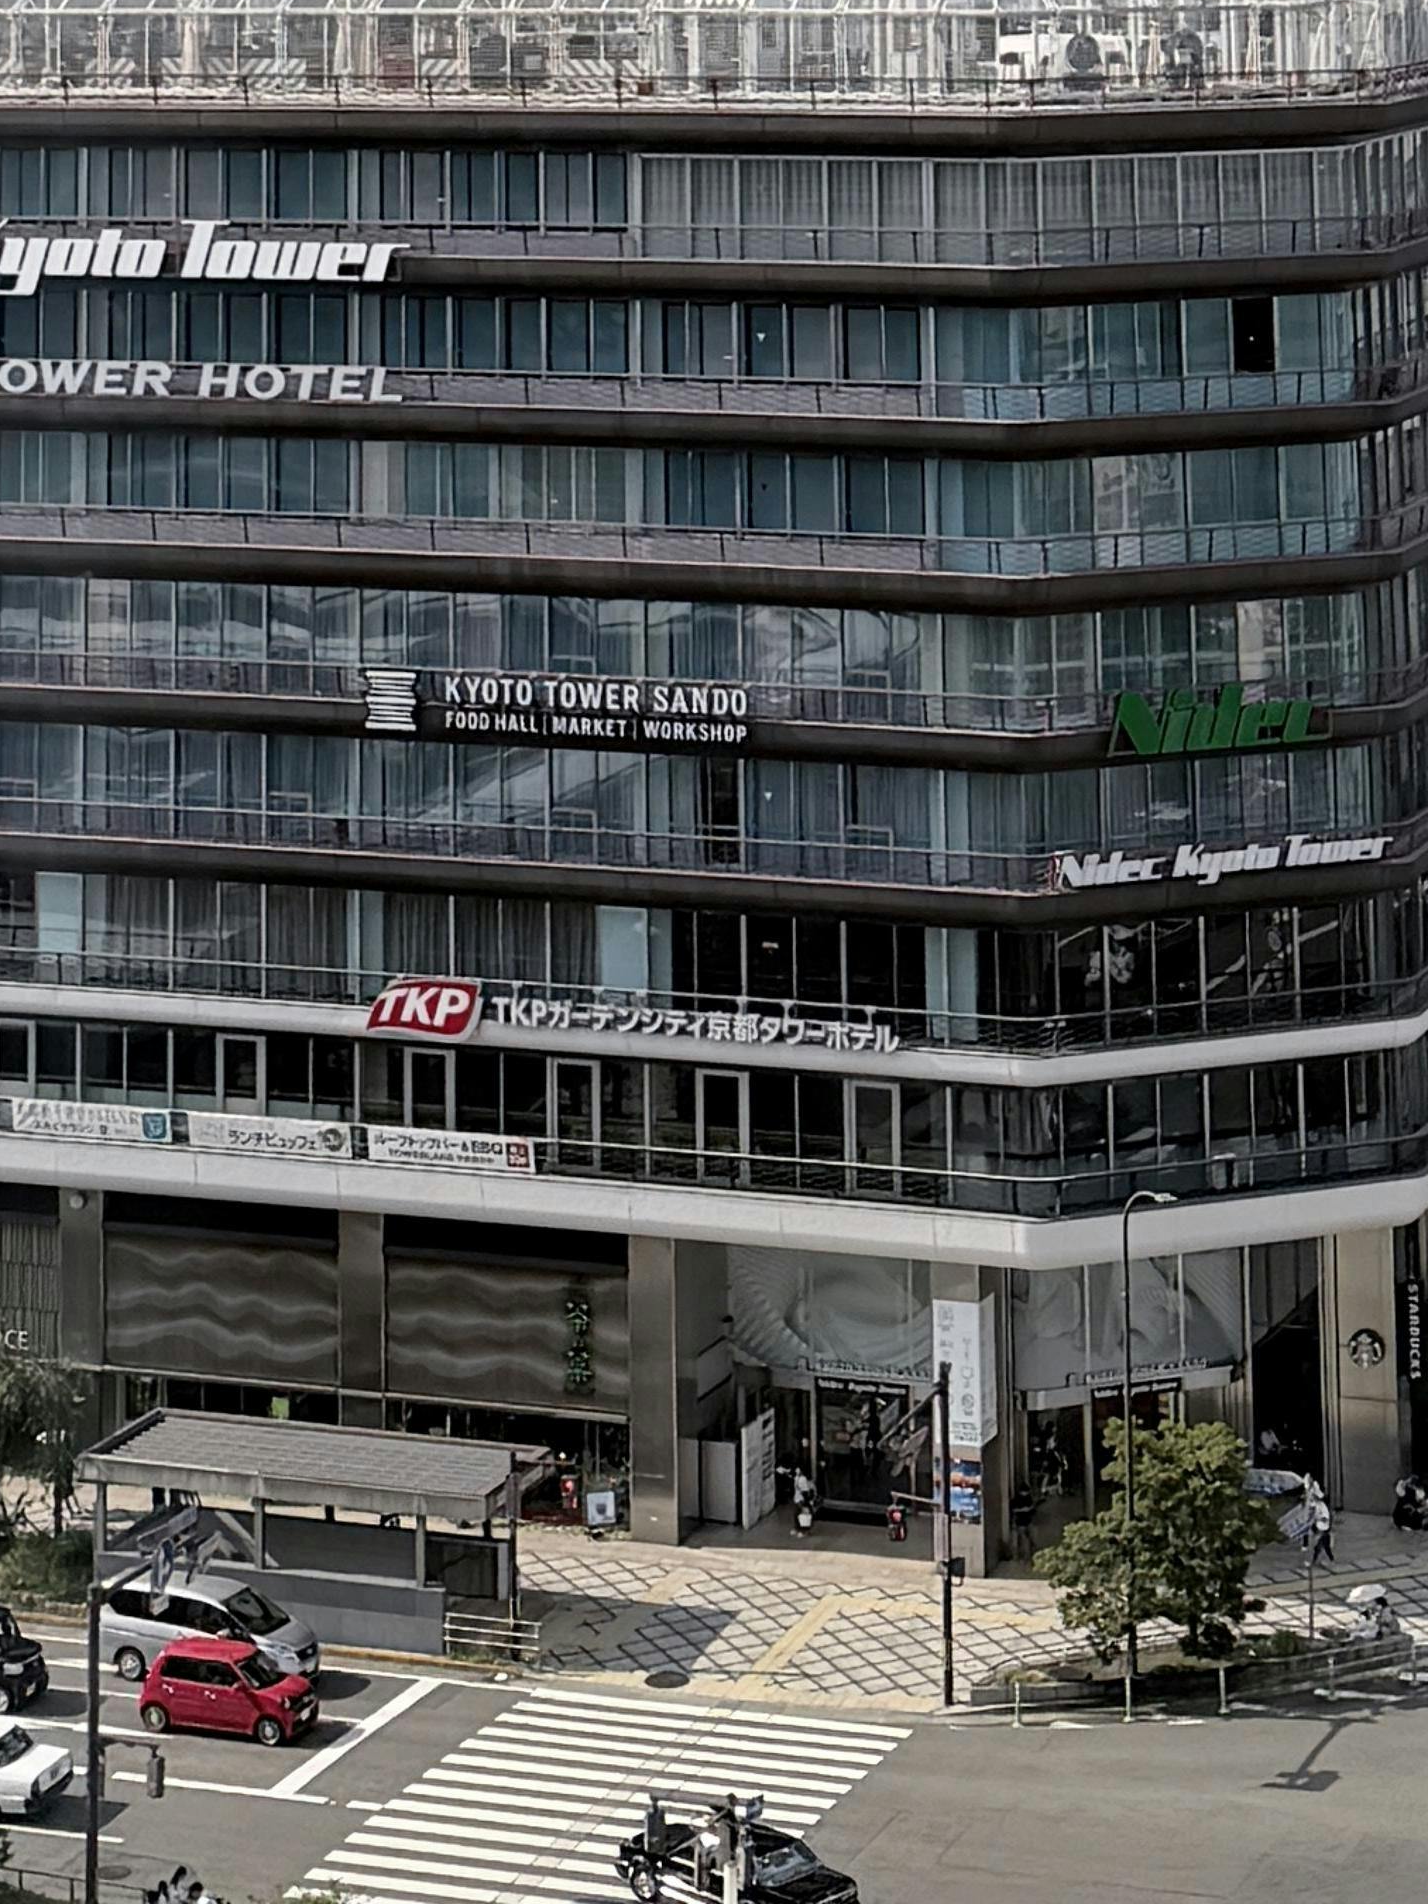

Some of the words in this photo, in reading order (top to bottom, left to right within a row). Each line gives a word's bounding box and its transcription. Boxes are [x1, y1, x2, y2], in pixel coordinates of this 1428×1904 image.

[180, 220, 411, 282] Tower
[198, 364, 403, 402] HOTEL
[445, 675, 533, 706] KYOTO
[544, 679, 640, 714] TOWER
[652, 686, 748, 717] SANDO
[445, 711, 489, 732] FOOD
[494, 713, 539, 735] HALL
[552, 716, 627, 739] MARKET
[643, 719, 748, 744] WORKSHOP
[1107, 681, 1333, 758] Nidec
[1058, 851, 1167, 888] Nidec
[1172, 842, 1280, 886] Kyoto
[1285, 834, 1394, 868] Tower
[378, 987, 471, 1025] TKP
